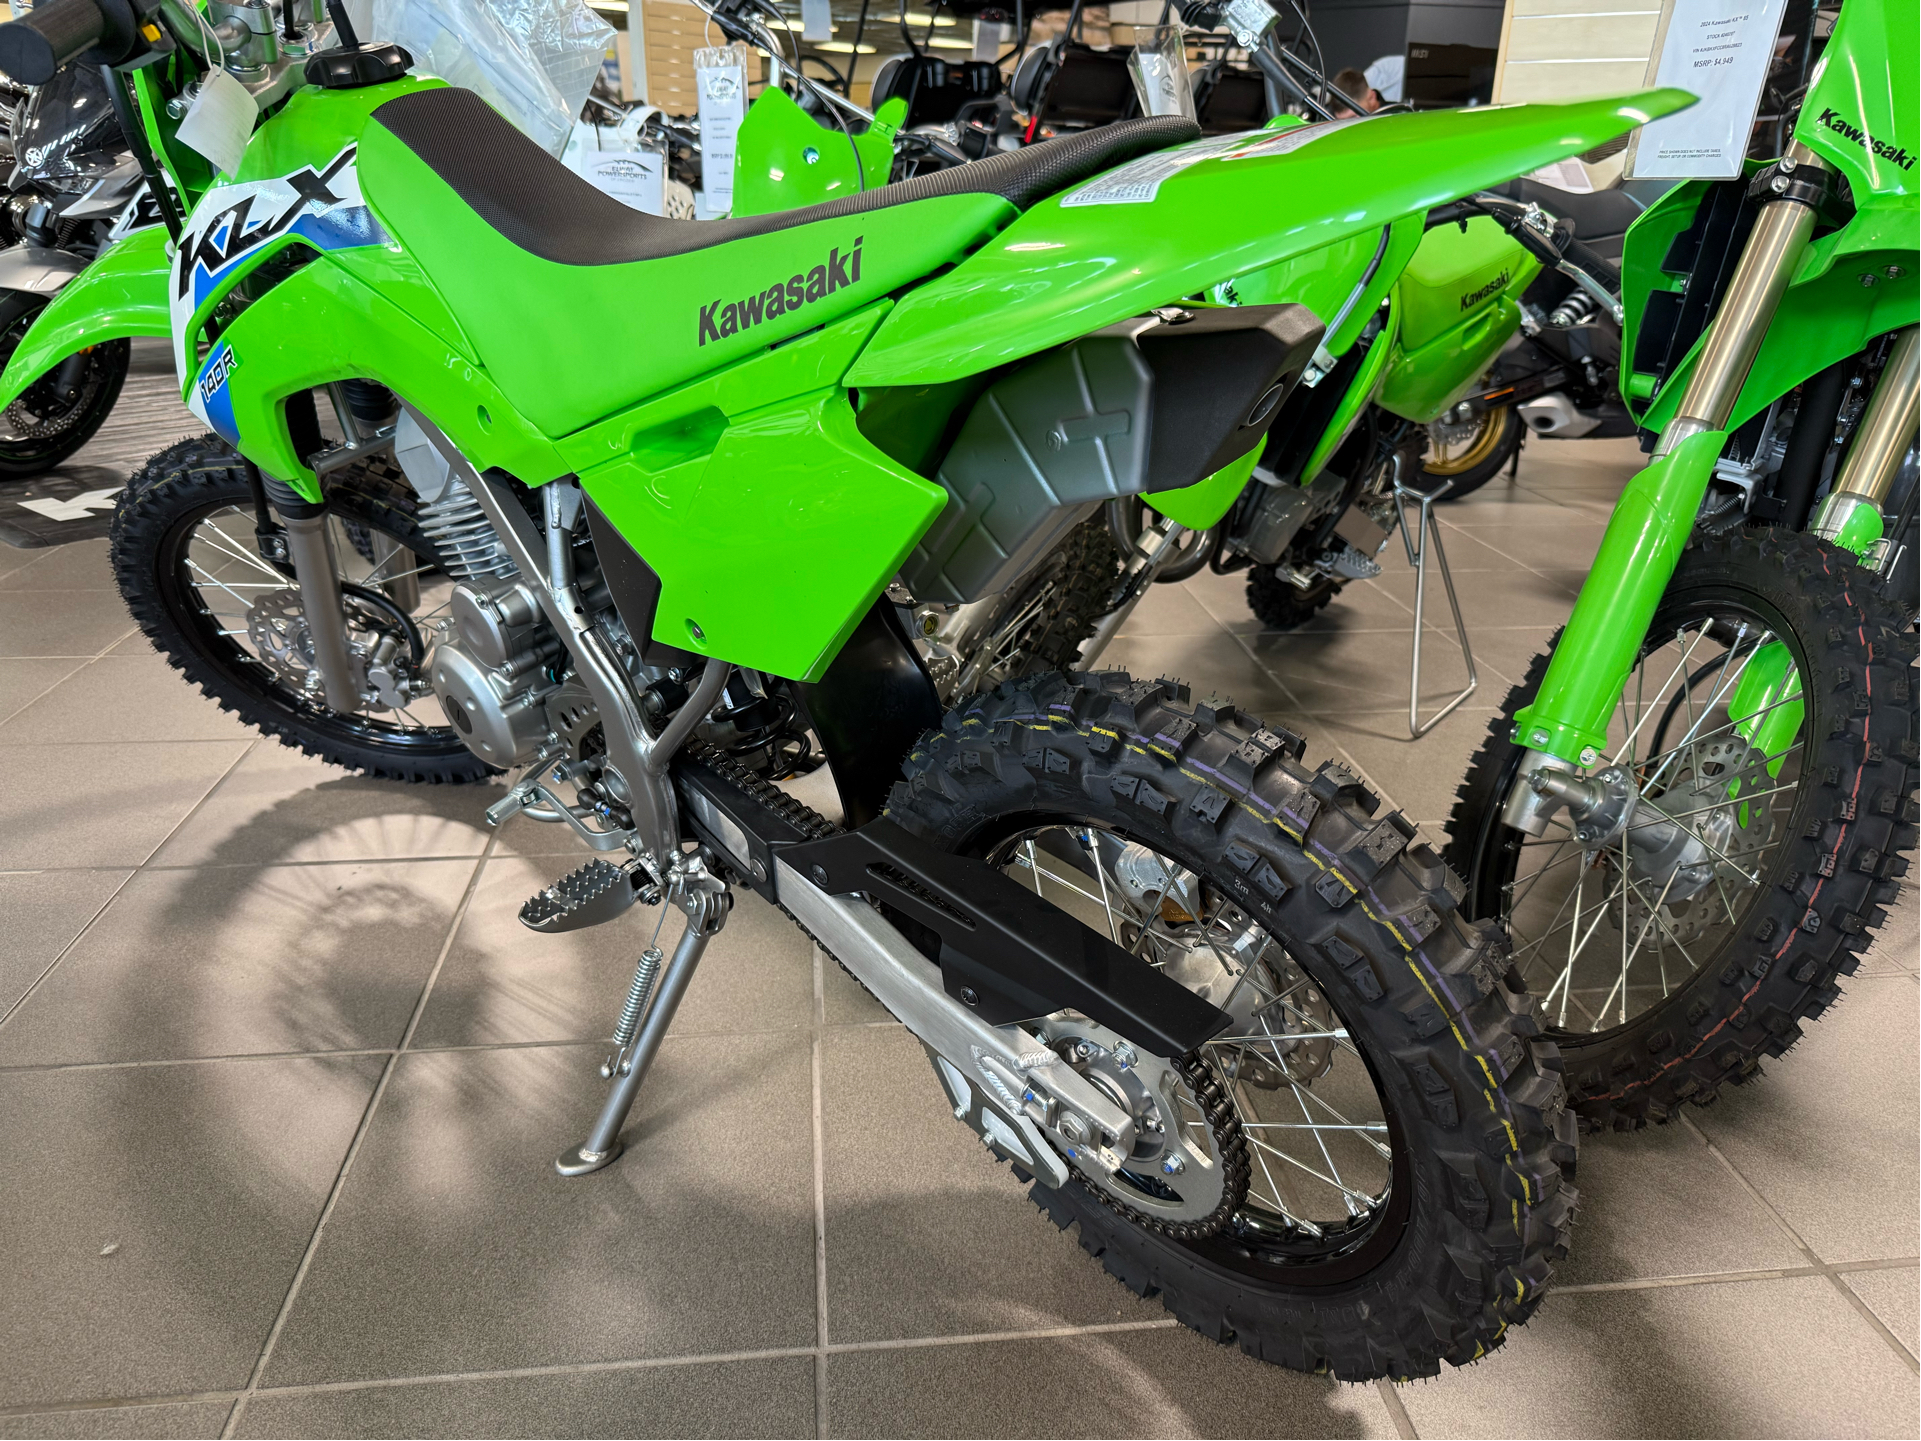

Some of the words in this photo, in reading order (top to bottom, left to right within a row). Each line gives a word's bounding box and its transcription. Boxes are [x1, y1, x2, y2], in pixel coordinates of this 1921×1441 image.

[1693, 59, 1713, 68] MSRP:
[1713, 56, 1734, 66] $4,949
[1816, 107, 1918, 171] Kawasaki
[178, 146, 357, 302] KLX
[699, 235, 864, 347] Kawasaki
[1460, 267, 1509, 312] Kawasaki
[200, 344, 238, 403] 140R
